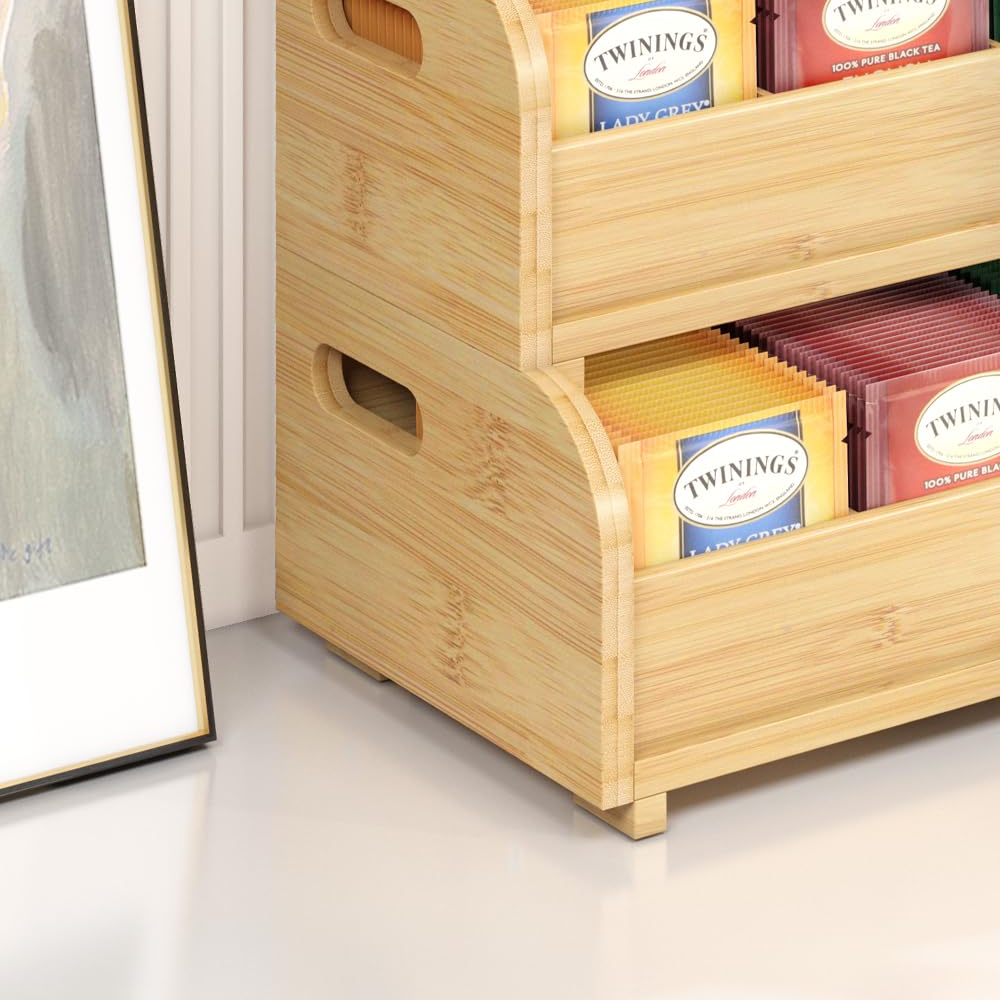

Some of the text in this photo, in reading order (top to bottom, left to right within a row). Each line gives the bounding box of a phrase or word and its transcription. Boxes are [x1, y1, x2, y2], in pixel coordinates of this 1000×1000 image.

[594, 32, 707, 72] TWININGS
[832, 61, 858, 72] 100%
[861, 54, 886, 66] PURE
[888, 47, 920, 62] BLACK
[922, 43, 940, 54] TEA
[684, 455, 798, 500] TWININGS
[924, 476, 952, 489] 100%
[954, 469, 978, 482] PURE
